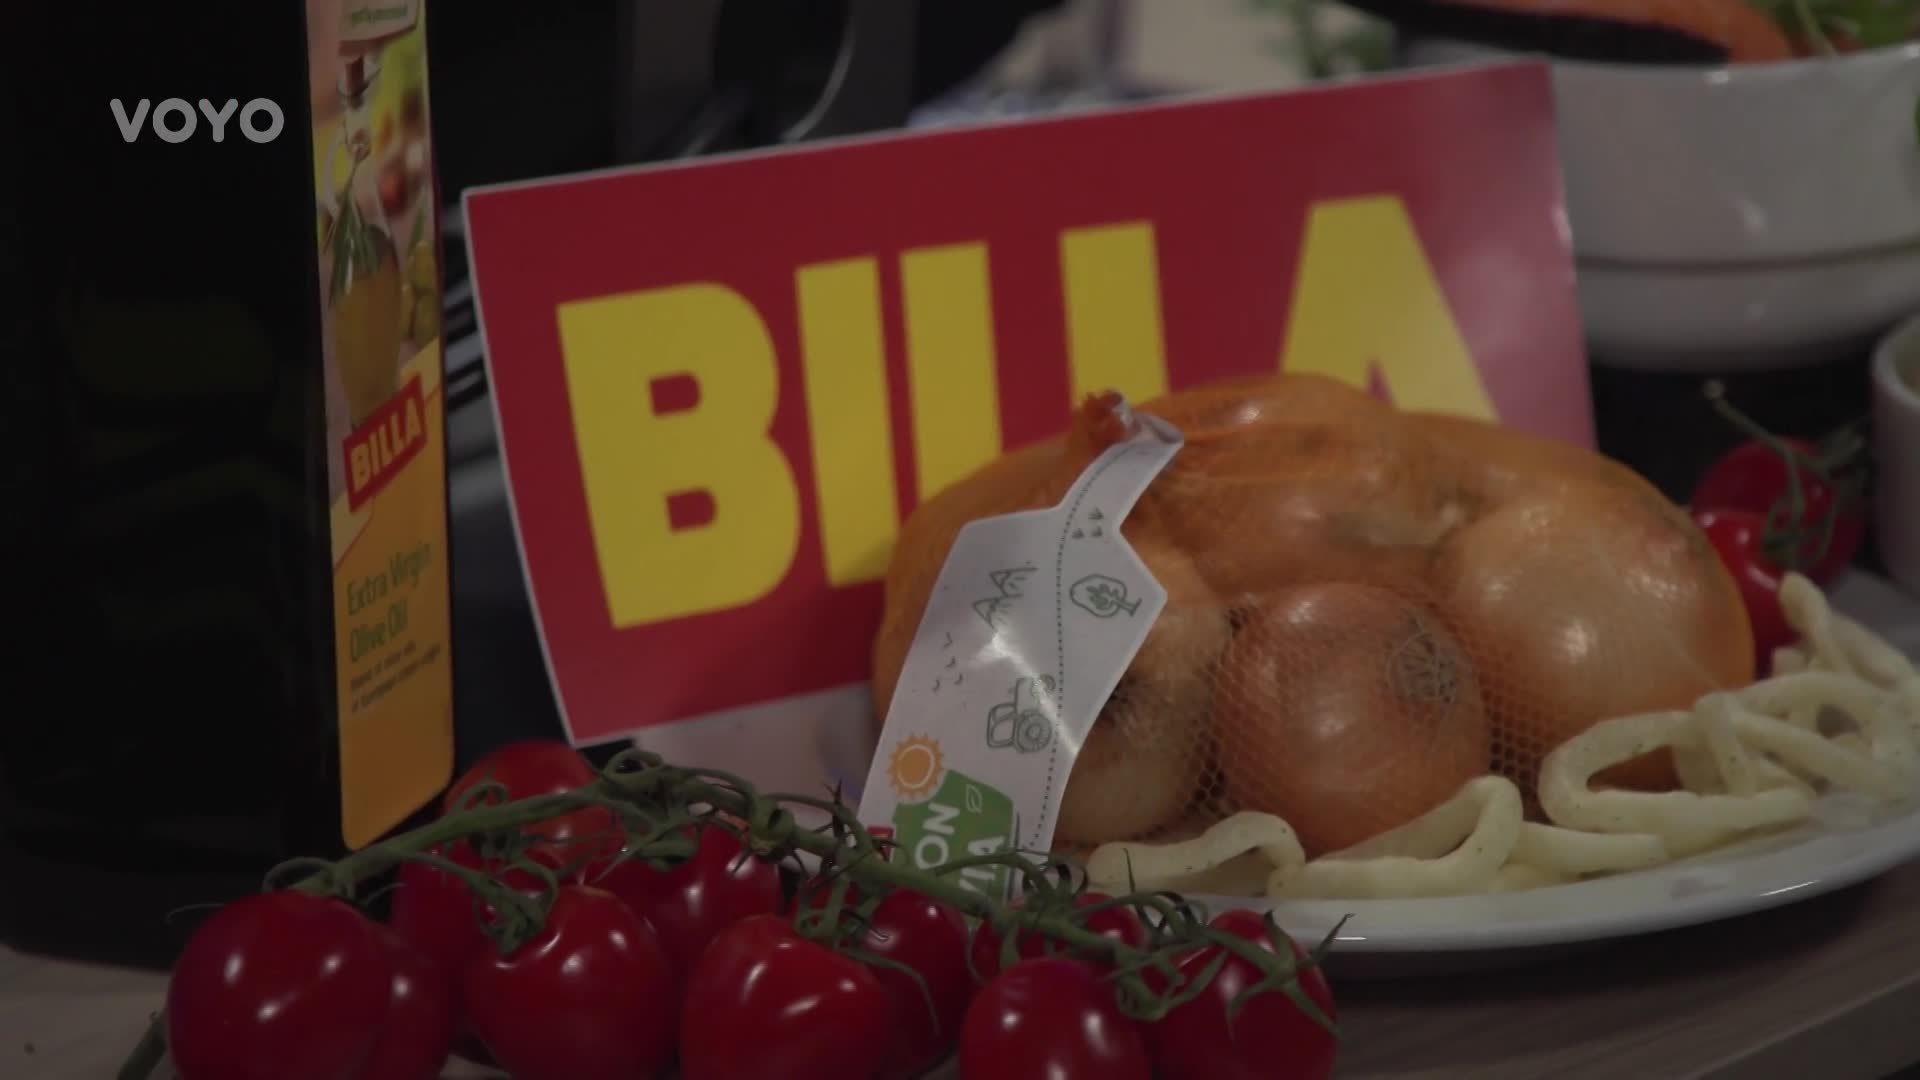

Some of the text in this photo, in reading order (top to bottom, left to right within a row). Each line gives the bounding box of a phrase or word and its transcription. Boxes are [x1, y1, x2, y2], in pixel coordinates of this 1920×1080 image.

[350, 396, 422, 492] BILLA
[347, 541, 431, 616] Extra Virgin
[350, 599, 409, 662] Olive Oil
[914, 801, 960, 870] ON
